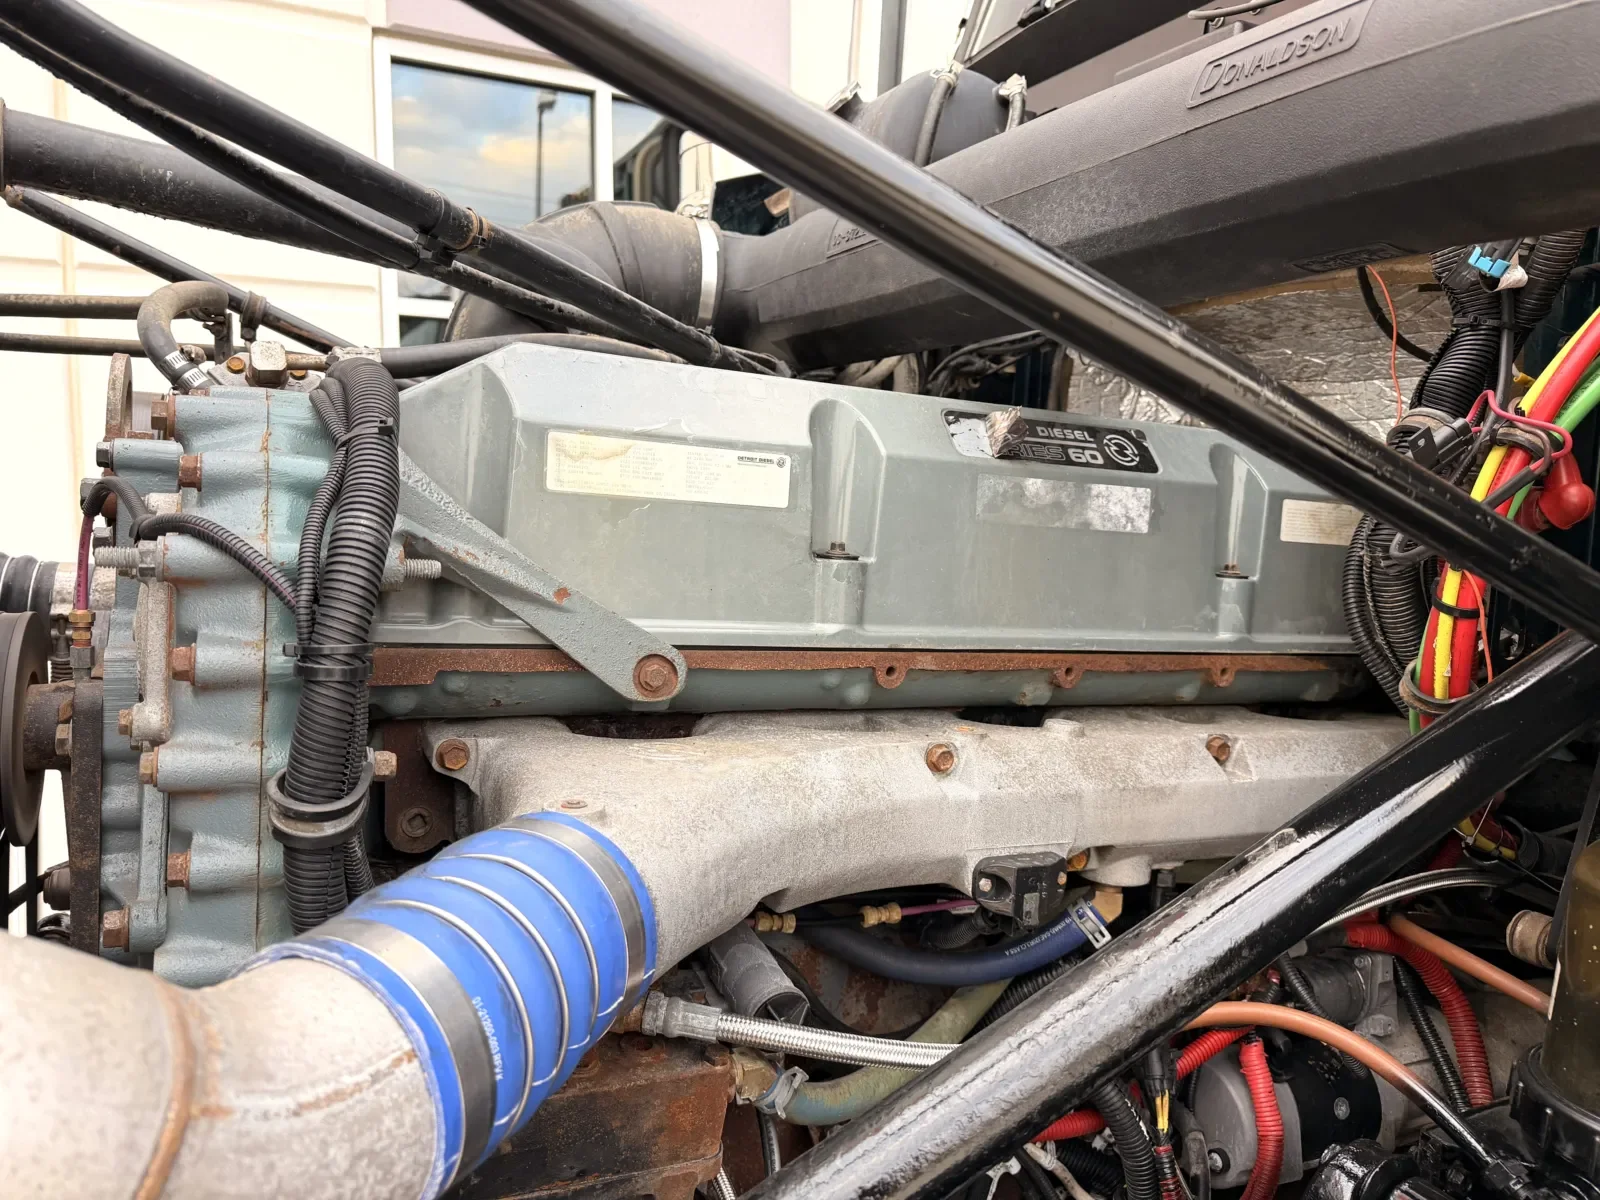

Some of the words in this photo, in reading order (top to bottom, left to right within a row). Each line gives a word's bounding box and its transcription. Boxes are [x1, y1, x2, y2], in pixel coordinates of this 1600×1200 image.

[1199, 17, 1352, 95] DONALDSON
[1036, 426, 1095, 442] DIESEL
[737, 455, 758, 463] DETROIT
[758, 457, 775, 465] DIESEL
[1067, 448, 1104, 465] 60
